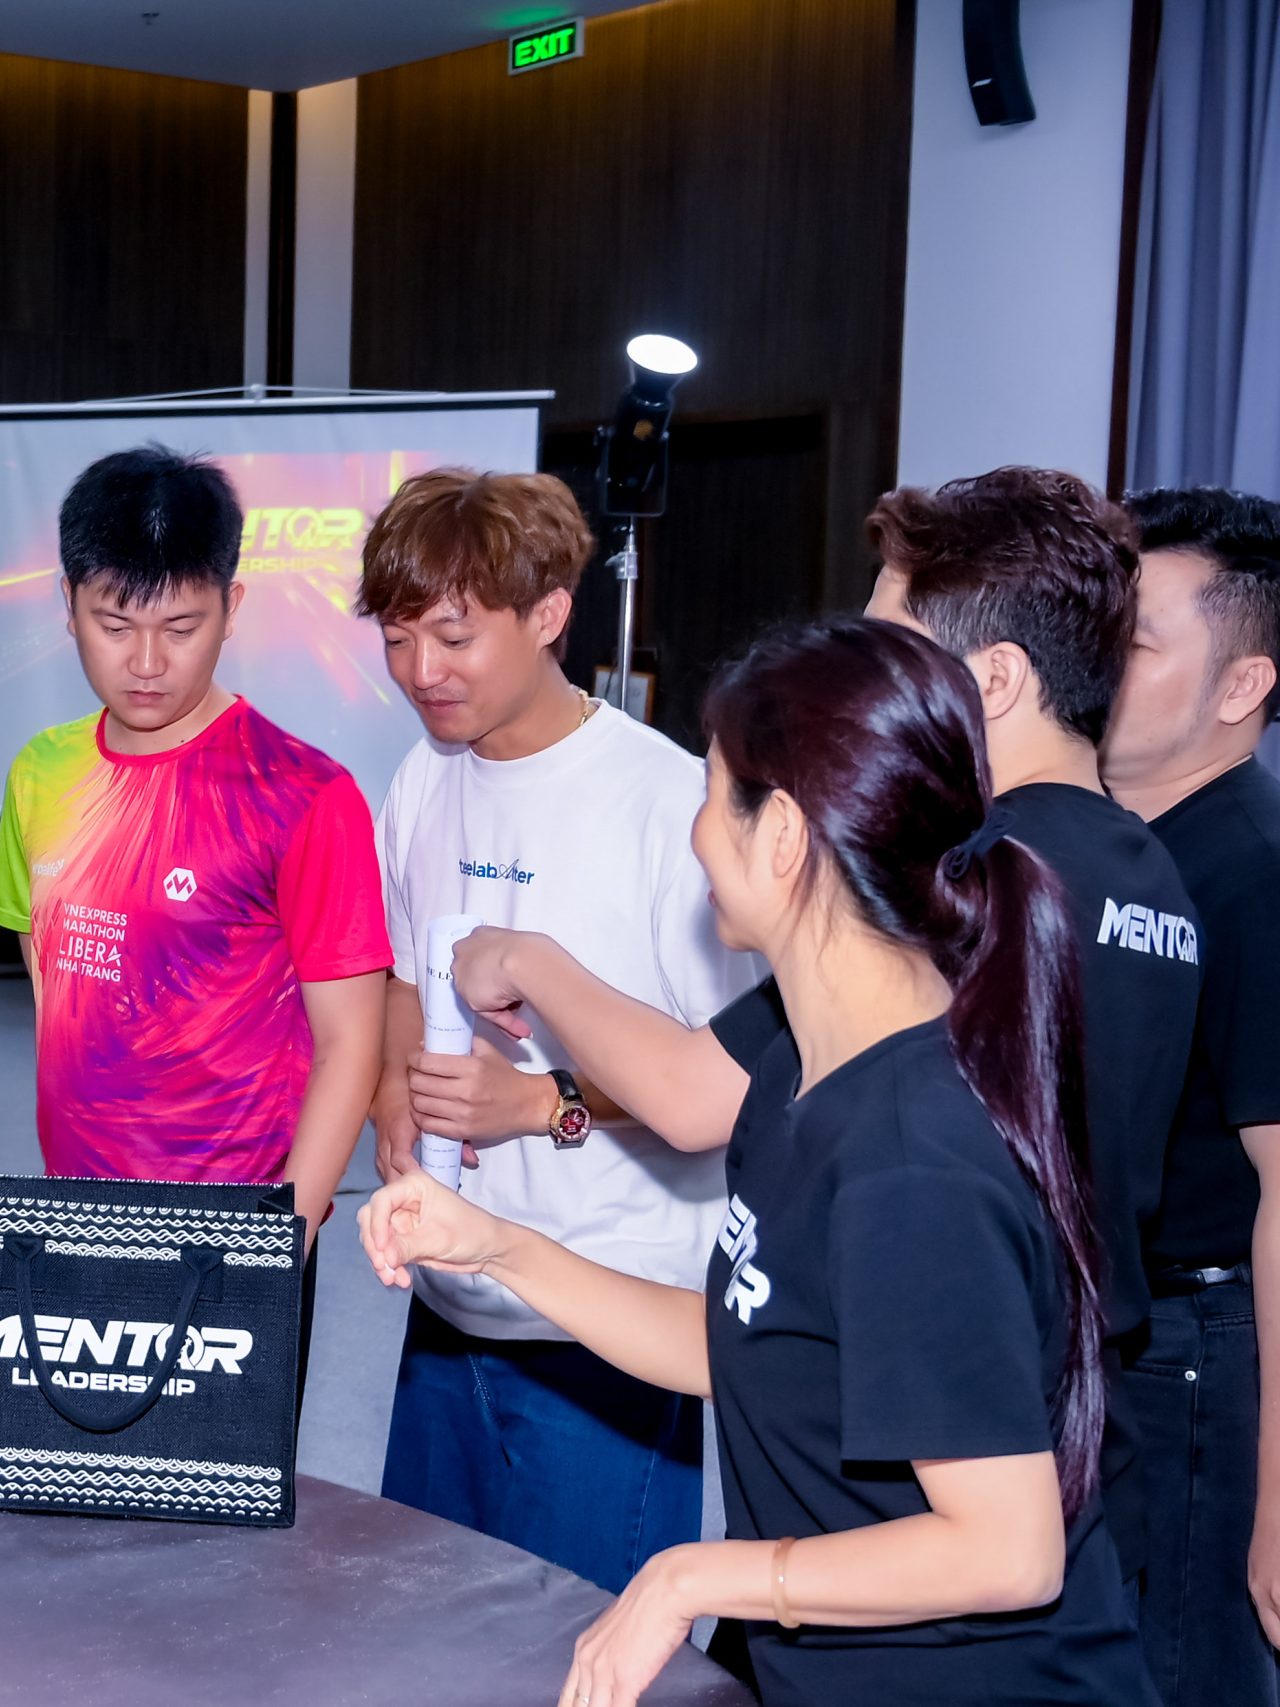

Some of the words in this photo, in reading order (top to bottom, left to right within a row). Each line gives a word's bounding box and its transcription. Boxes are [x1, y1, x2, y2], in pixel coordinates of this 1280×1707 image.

[515, 28, 574, 67] EXIT
[64, 902, 128, 927] VNEXPRESS
[1096, 897, 1199, 966] MENTOR
[59, 932, 122, 967] LIBERA
[57, 957, 78, 973] NHA
[81, 962, 121, 982] TRANG
[11, 1367, 196, 1397] LADERSIP
